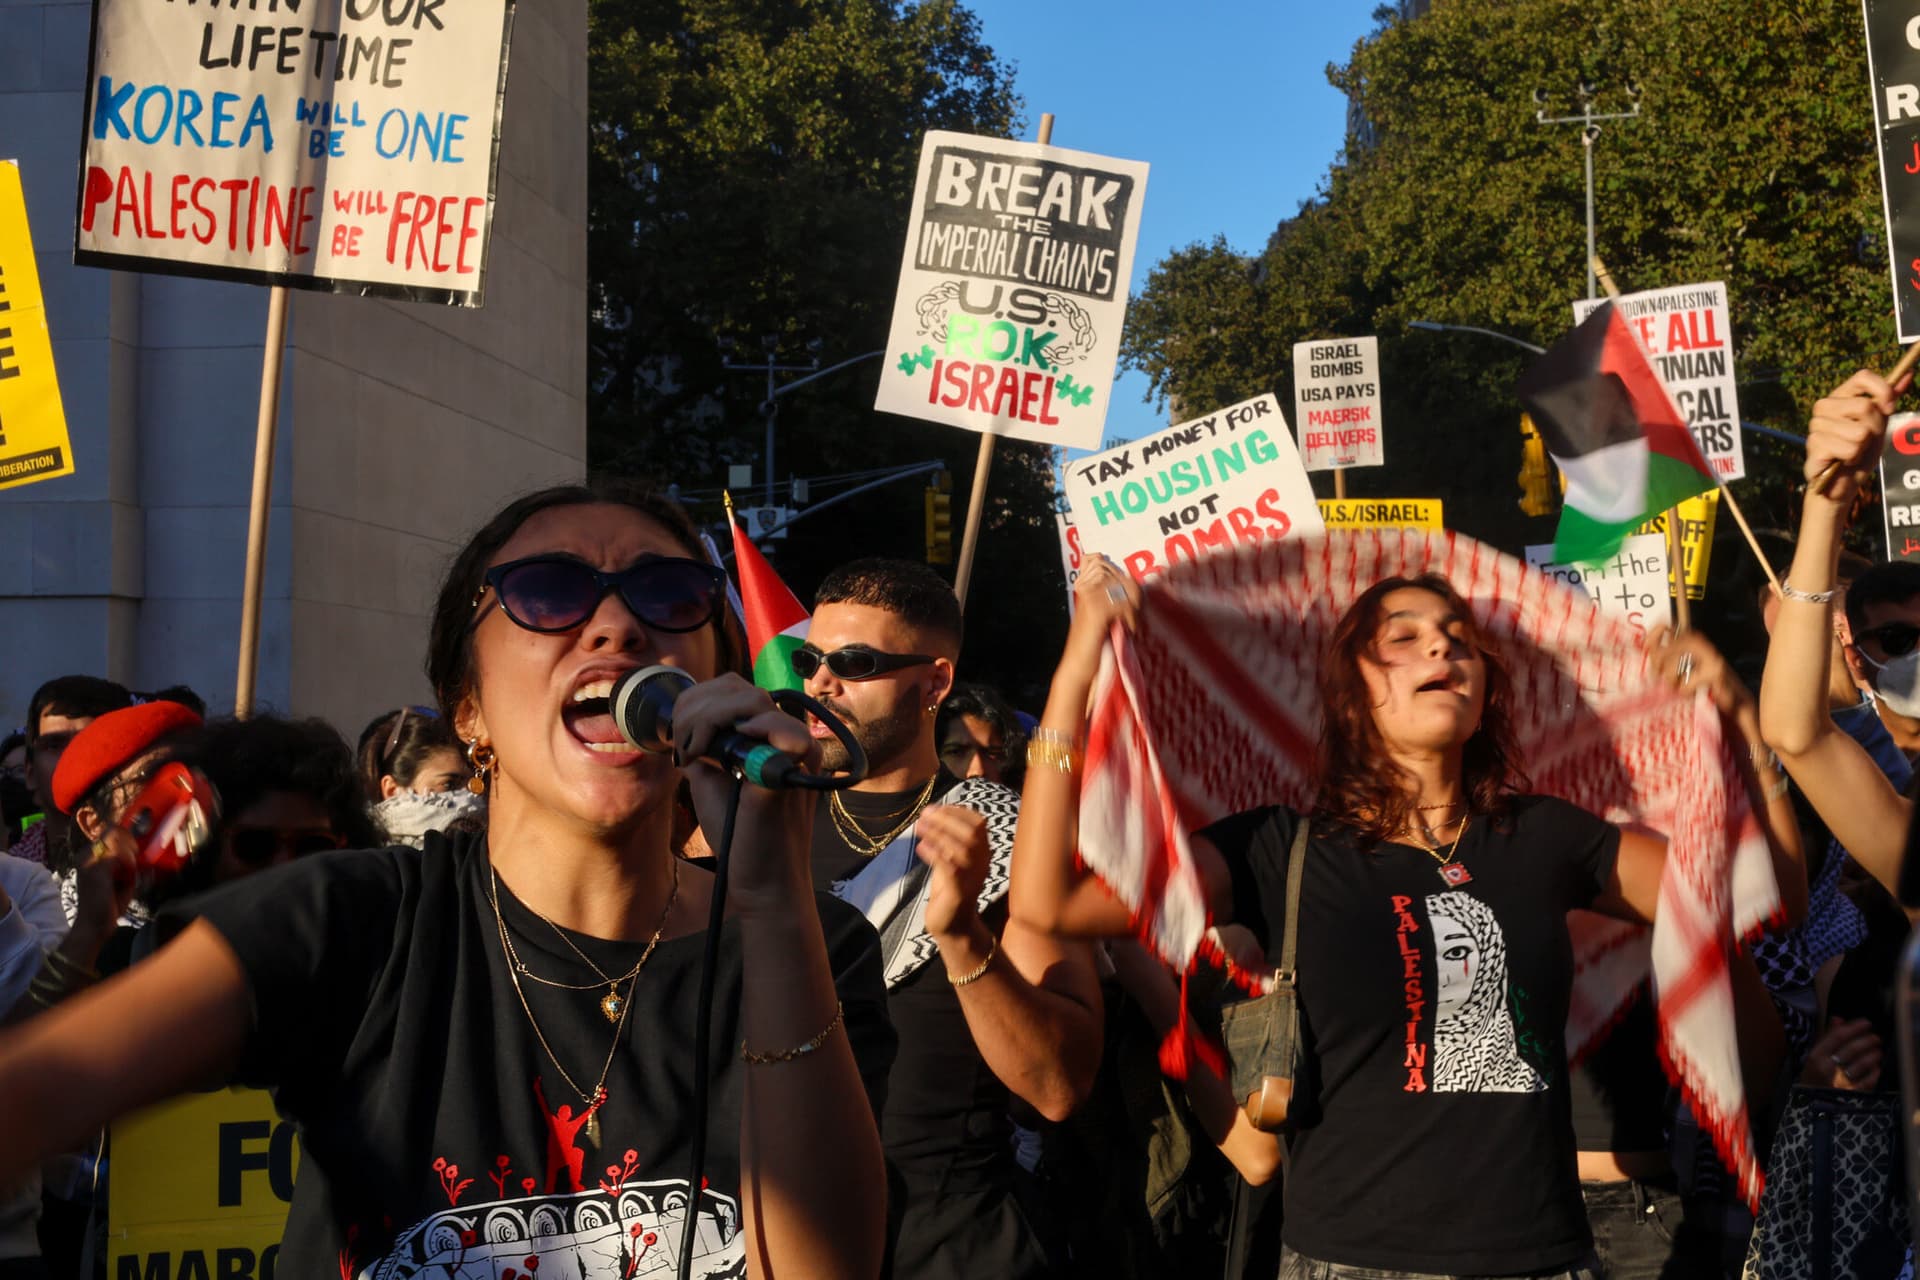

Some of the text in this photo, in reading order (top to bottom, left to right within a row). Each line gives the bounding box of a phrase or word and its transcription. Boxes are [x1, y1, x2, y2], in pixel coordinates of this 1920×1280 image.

[199, 22, 413, 88] LIFETIME
[93, 75, 469, 163] KOREA WILL BE ONE
[935, 153, 1121, 230] BREAK
[82, 165, 486, 274] PALESTINE WILL BE FREE
[996, 214, 1053, 236] THE
[919, 221, 1115, 295] IMPERIAL CHAINS
[958, 280, 1056, 328] U.S.
[1310, 344, 1363, 362] ISRAEL
[1666, 309, 1724, 353] ALL
[1310, 361, 1364, 379] BOMBS
[928, 359, 1059, 426] ISRAEL
[1301, 383, 1376, 403] USA PAYS
[1308, 405, 1371, 427] MAERSK
[1077, 400, 1272, 487] TAX MONEY FOR
[1306, 428, 1377, 450] DELIVERS
[0, 454, 55, 478] IBERATION
[1090, 429, 1280, 527] HOUSING
[1158, 494, 1220, 536] NOT
[1319, 504, 1430, 522] U.S./ISRAEL:
[1123, 488, 1292, 586] BOMBS
[1611, 553, 1662, 578] the
[1614, 583, 1656, 610] to
[1391, 895, 1428, 1092] PALESTINA
